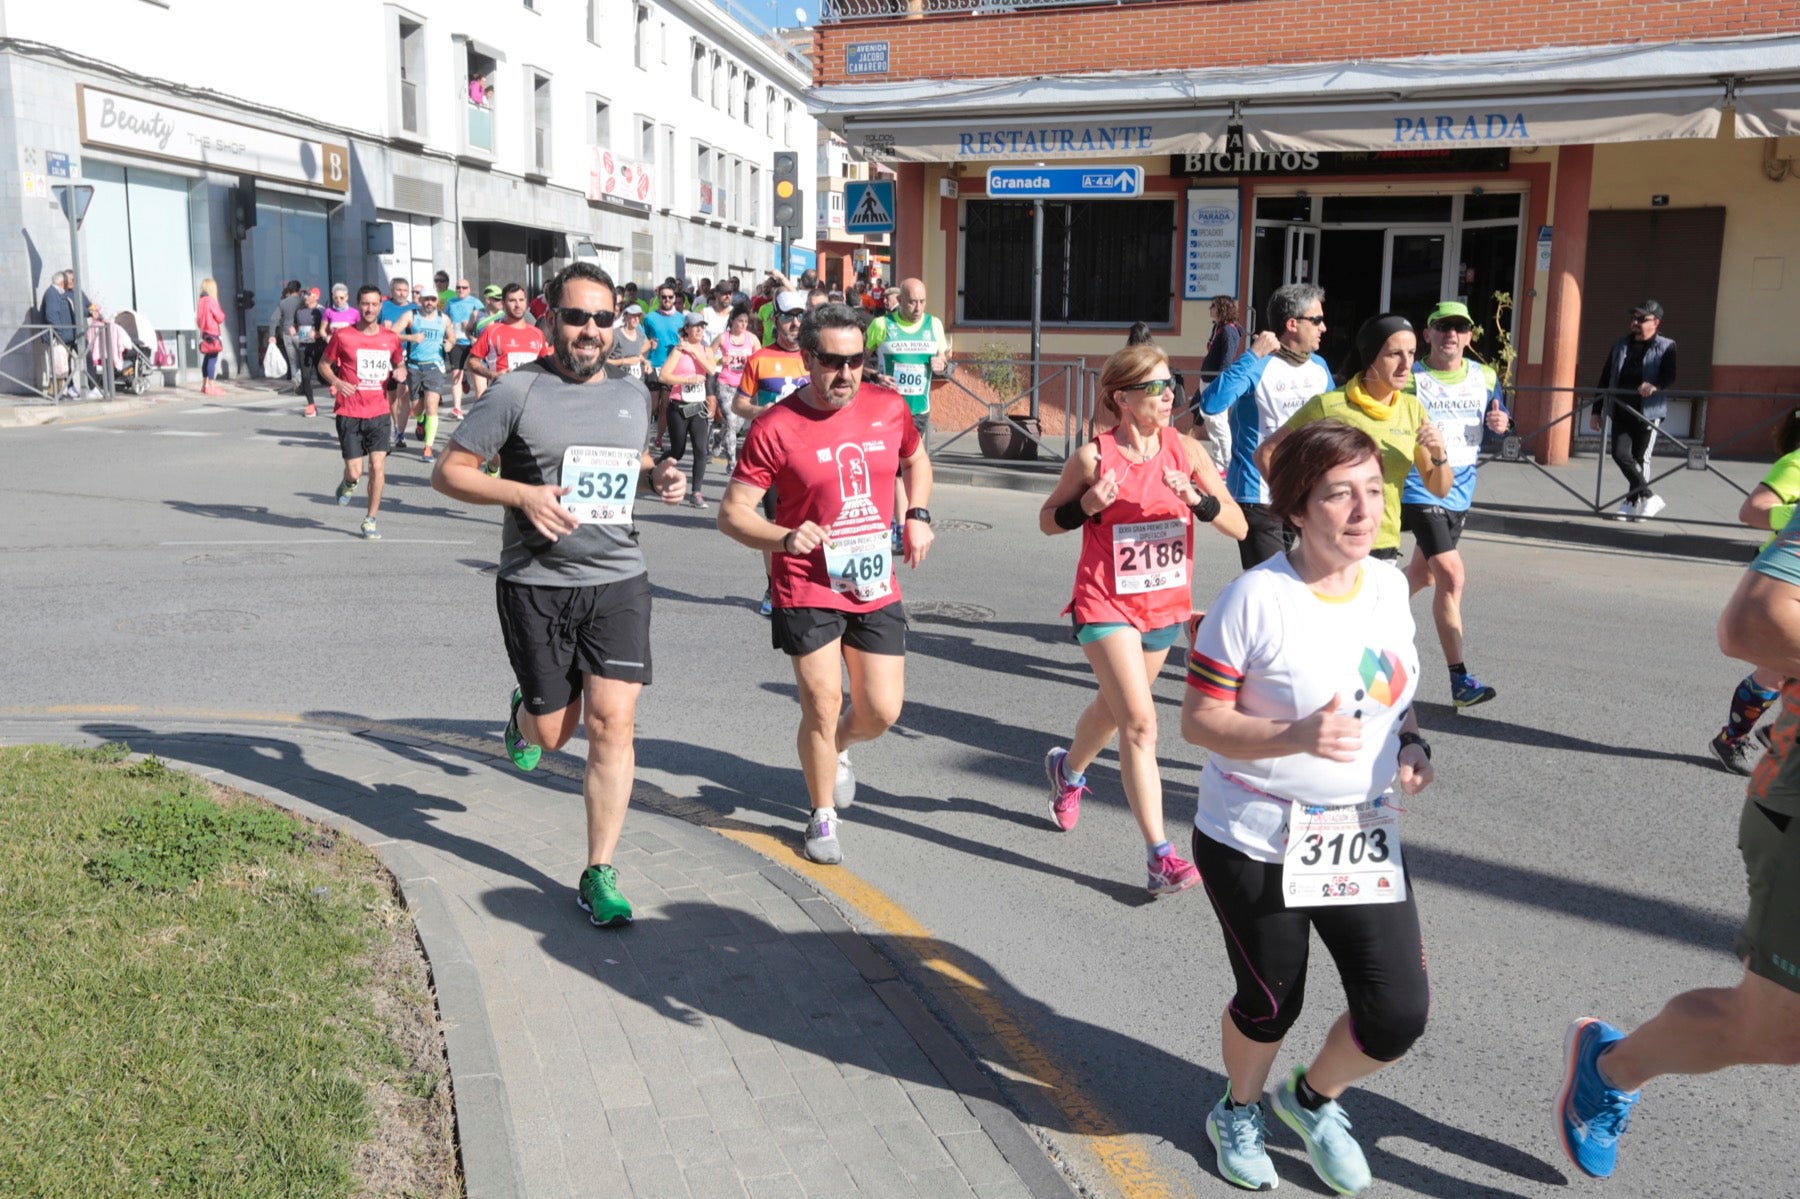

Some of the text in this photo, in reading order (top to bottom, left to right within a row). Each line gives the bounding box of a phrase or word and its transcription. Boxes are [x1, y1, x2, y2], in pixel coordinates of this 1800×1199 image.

[857, 44, 887, 52] AVENIDA
[858, 52, 885, 62] JACOBO
[849, 61, 887, 72] CAMARERO
[100, 98, 175, 150] Beauty
[1393, 112, 1529, 142] PARADA
[187, 132, 246, 154] THE SHOP
[959, 126, 1153, 155] RESTAURANTE
[330, 152, 342, 181] B
[1184, 152, 1320, 172] BICHITOS
[991, 176, 1112, 189] Granada A-44
[362, 358, 387, 370] 3146
[898, 372, 922, 385] 806
[1428, 400, 1481, 409] MARACENA
[577, 472, 628, 499] 532
[1119, 540, 1183, 572] 2186
[842, 554, 884, 581] 469
[1301, 828, 1389, 866] 3103
